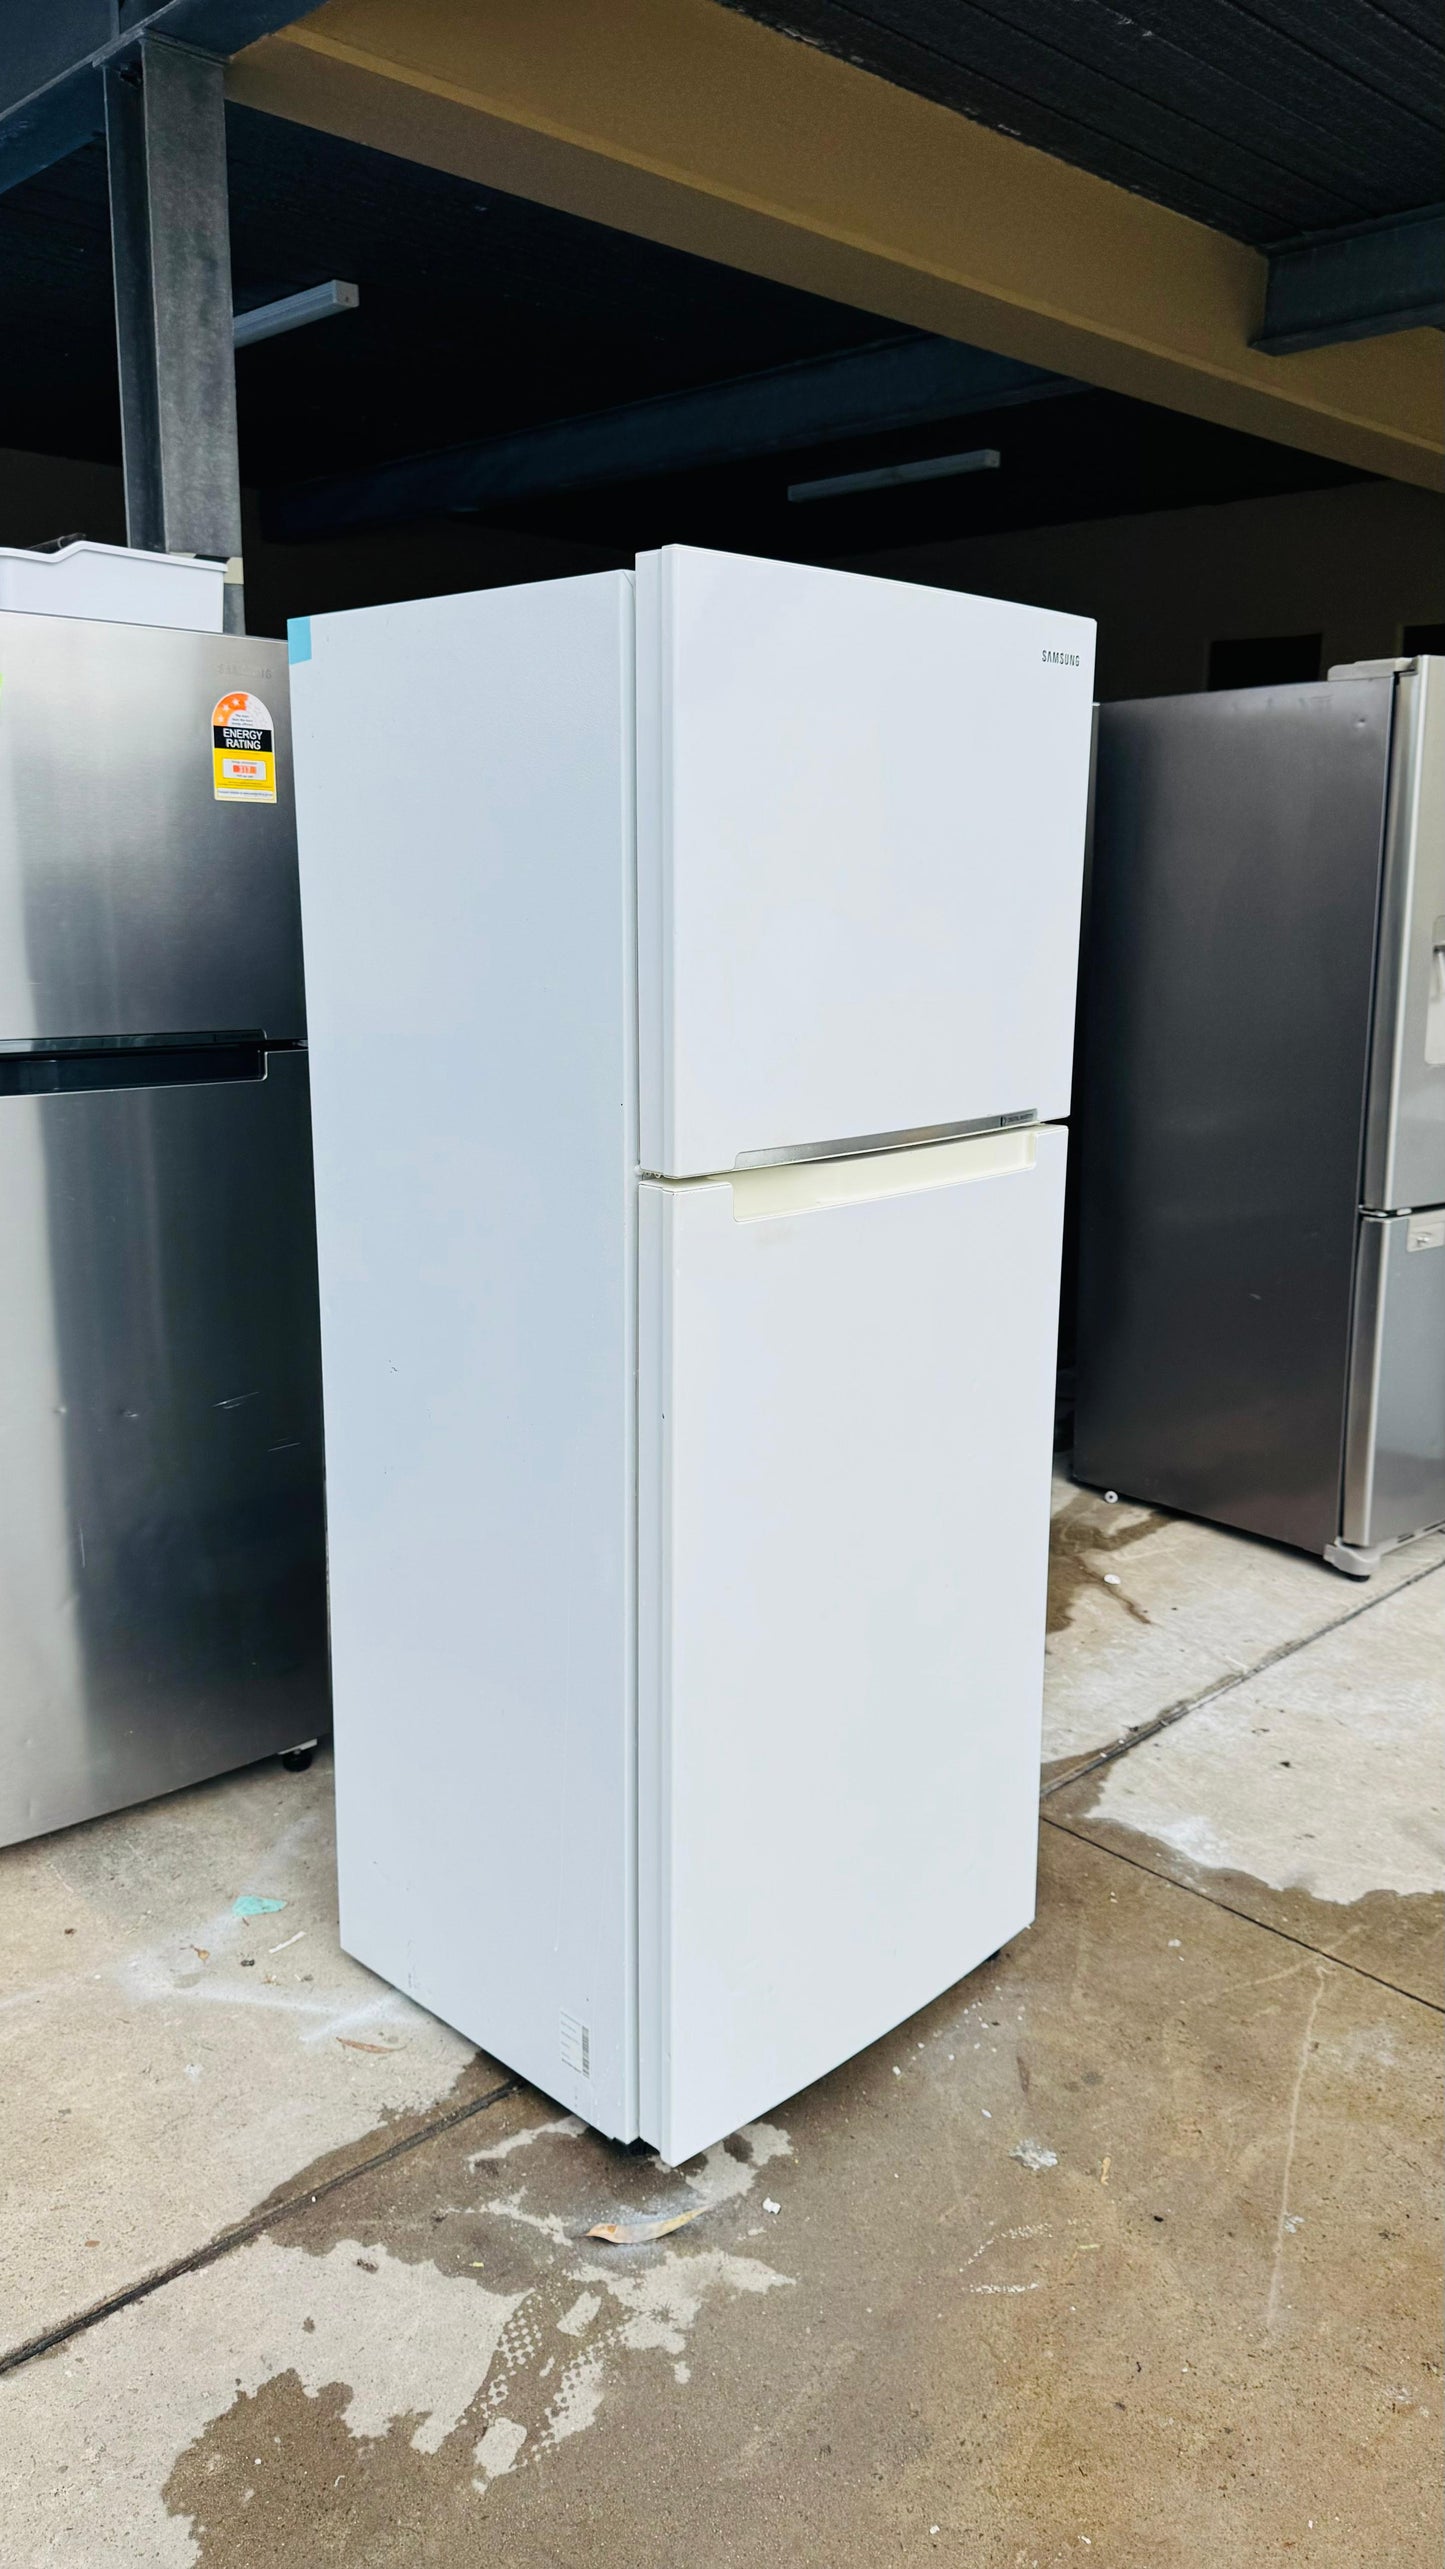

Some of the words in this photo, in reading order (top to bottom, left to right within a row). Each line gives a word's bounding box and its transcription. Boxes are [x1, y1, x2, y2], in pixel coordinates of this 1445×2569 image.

[1042, 650, 1080, 667] SAMSUNG
[223, 728, 263, 740] ENERGY
[226, 738, 261, 750] RATING
